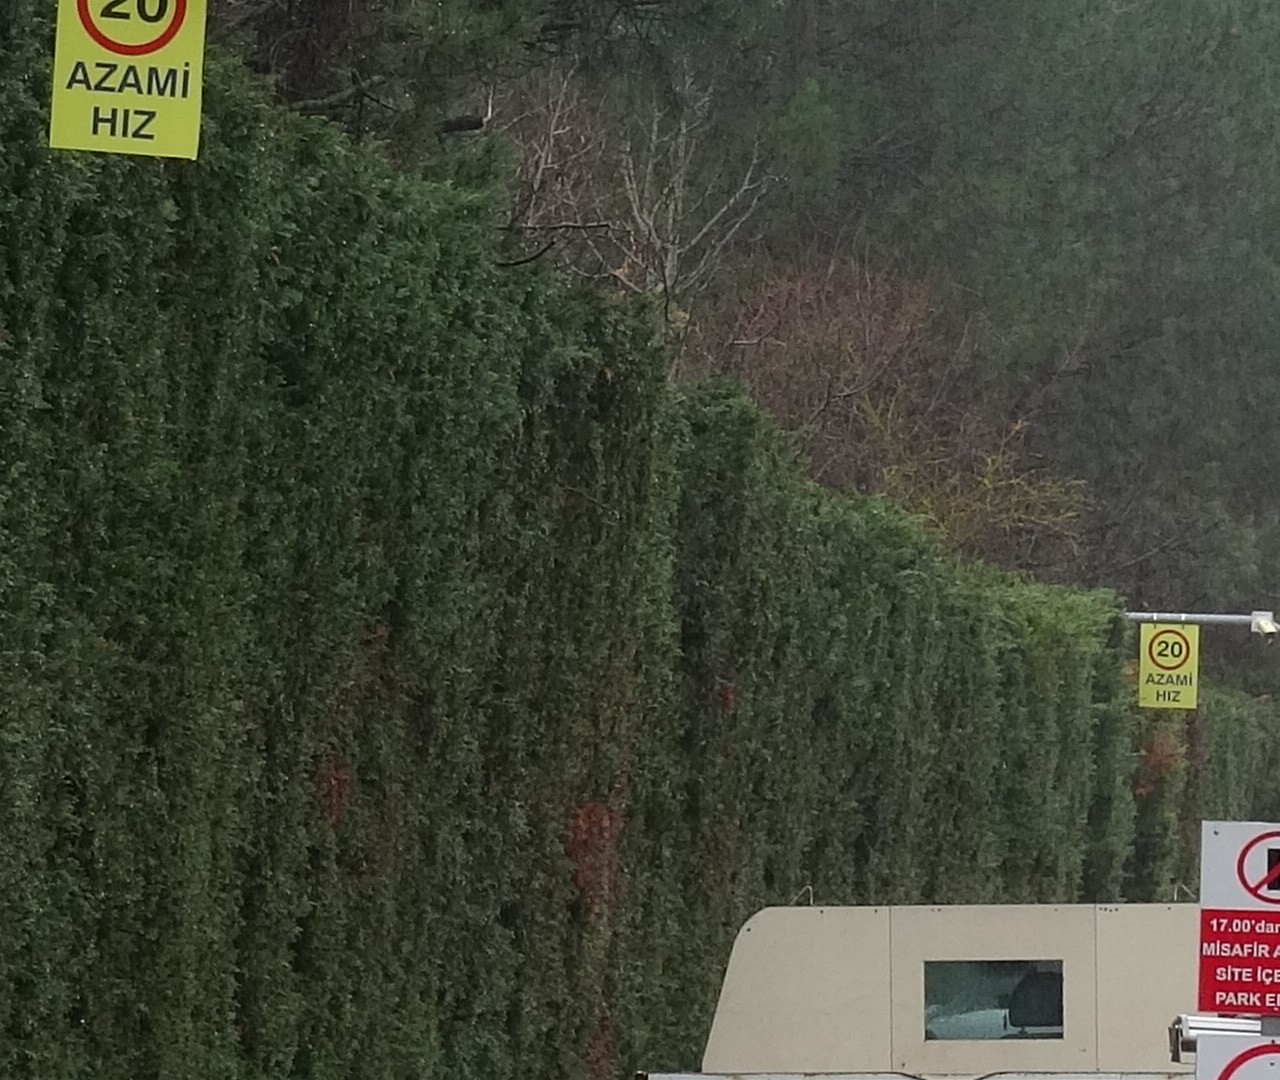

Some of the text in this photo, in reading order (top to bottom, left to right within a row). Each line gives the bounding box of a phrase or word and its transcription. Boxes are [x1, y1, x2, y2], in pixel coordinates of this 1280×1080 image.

[66, 61, 190, 98] AZAMİ
[92, 106, 157, 140] HIZ
[1157, 640, 1182, 658] 20
[1145, 672, 1192, 686] AZAMİ
[1156, 690, 1181, 702] HIZ
[1202, 940, 1270, 957] MİSAFİR
[1216, 965, 1253, 981] SİTE
[1215, 992, 1261, 1006] PARK
